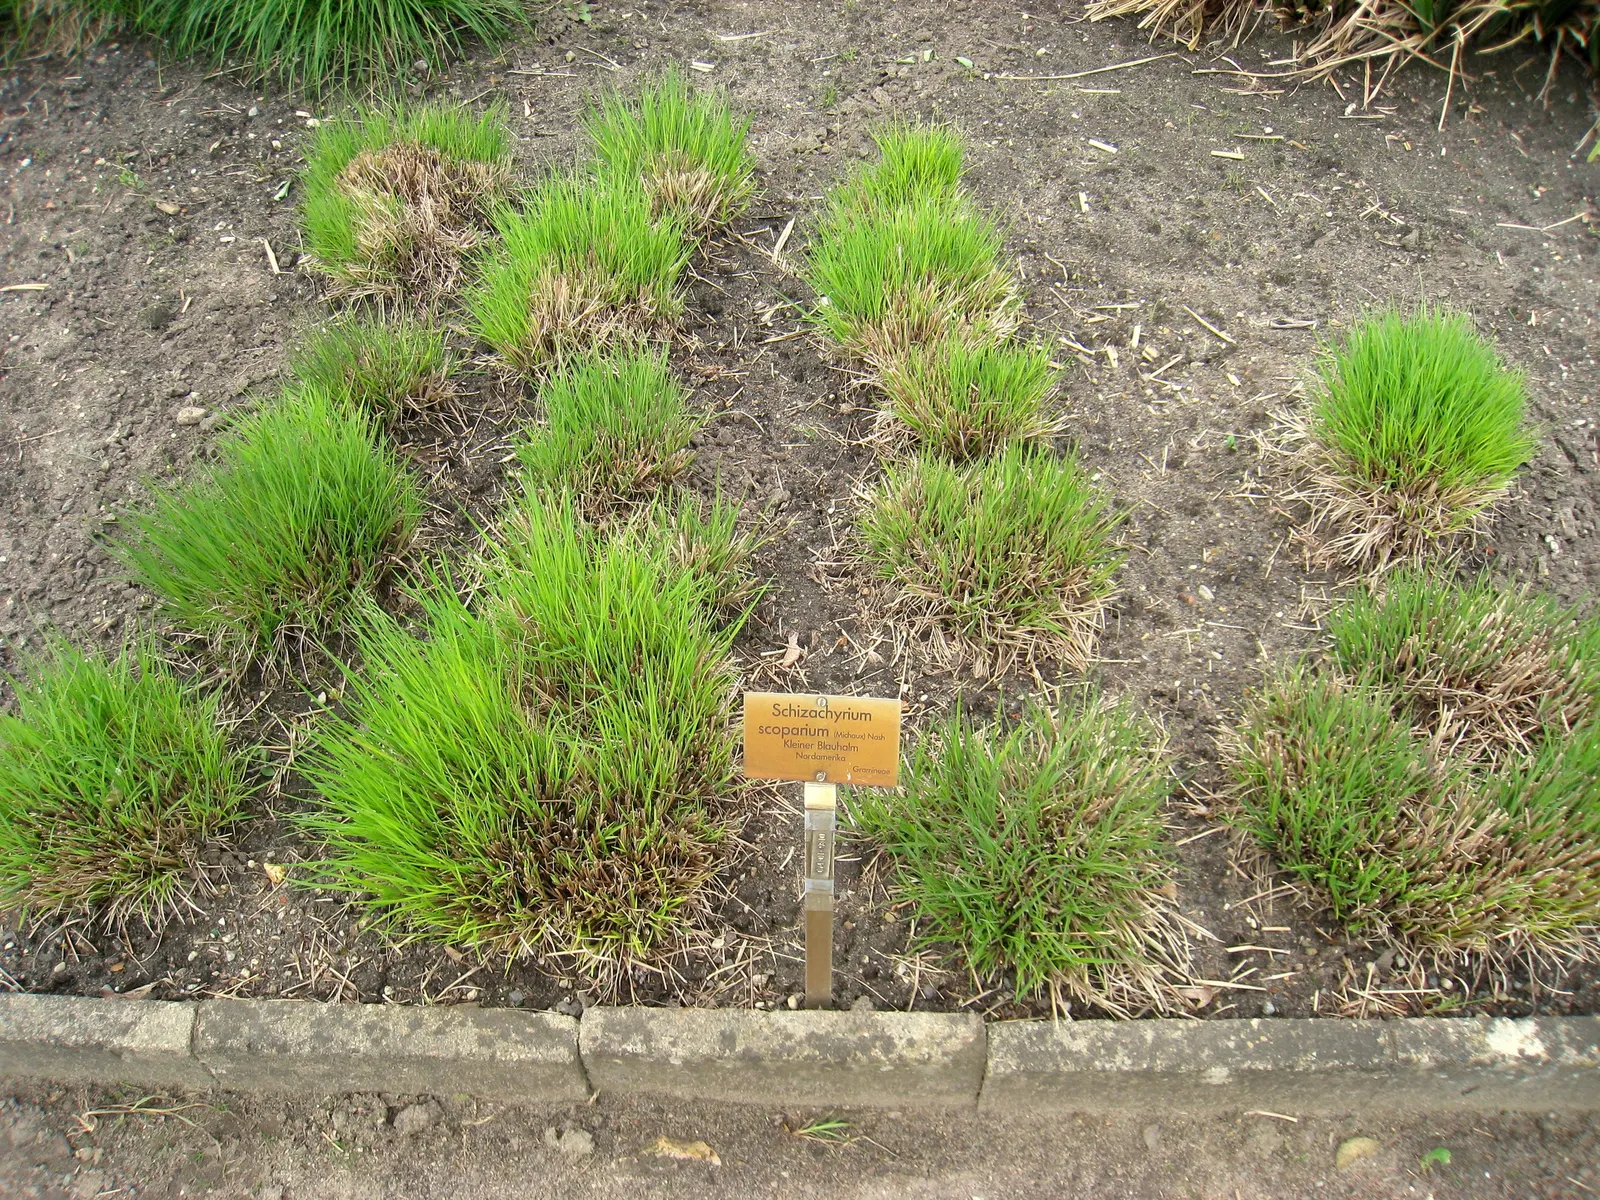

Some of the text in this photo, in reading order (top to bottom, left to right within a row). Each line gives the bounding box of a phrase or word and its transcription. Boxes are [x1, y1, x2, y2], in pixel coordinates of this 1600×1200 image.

[772, 703, 872, 723] Schizachyrium
[758, 724, 886, 741] scoparium (Michaux) Nash
[783, 740, 859, 752] Kleiner Blauhalm
[795, 752, 846, 762] Nordamerika
